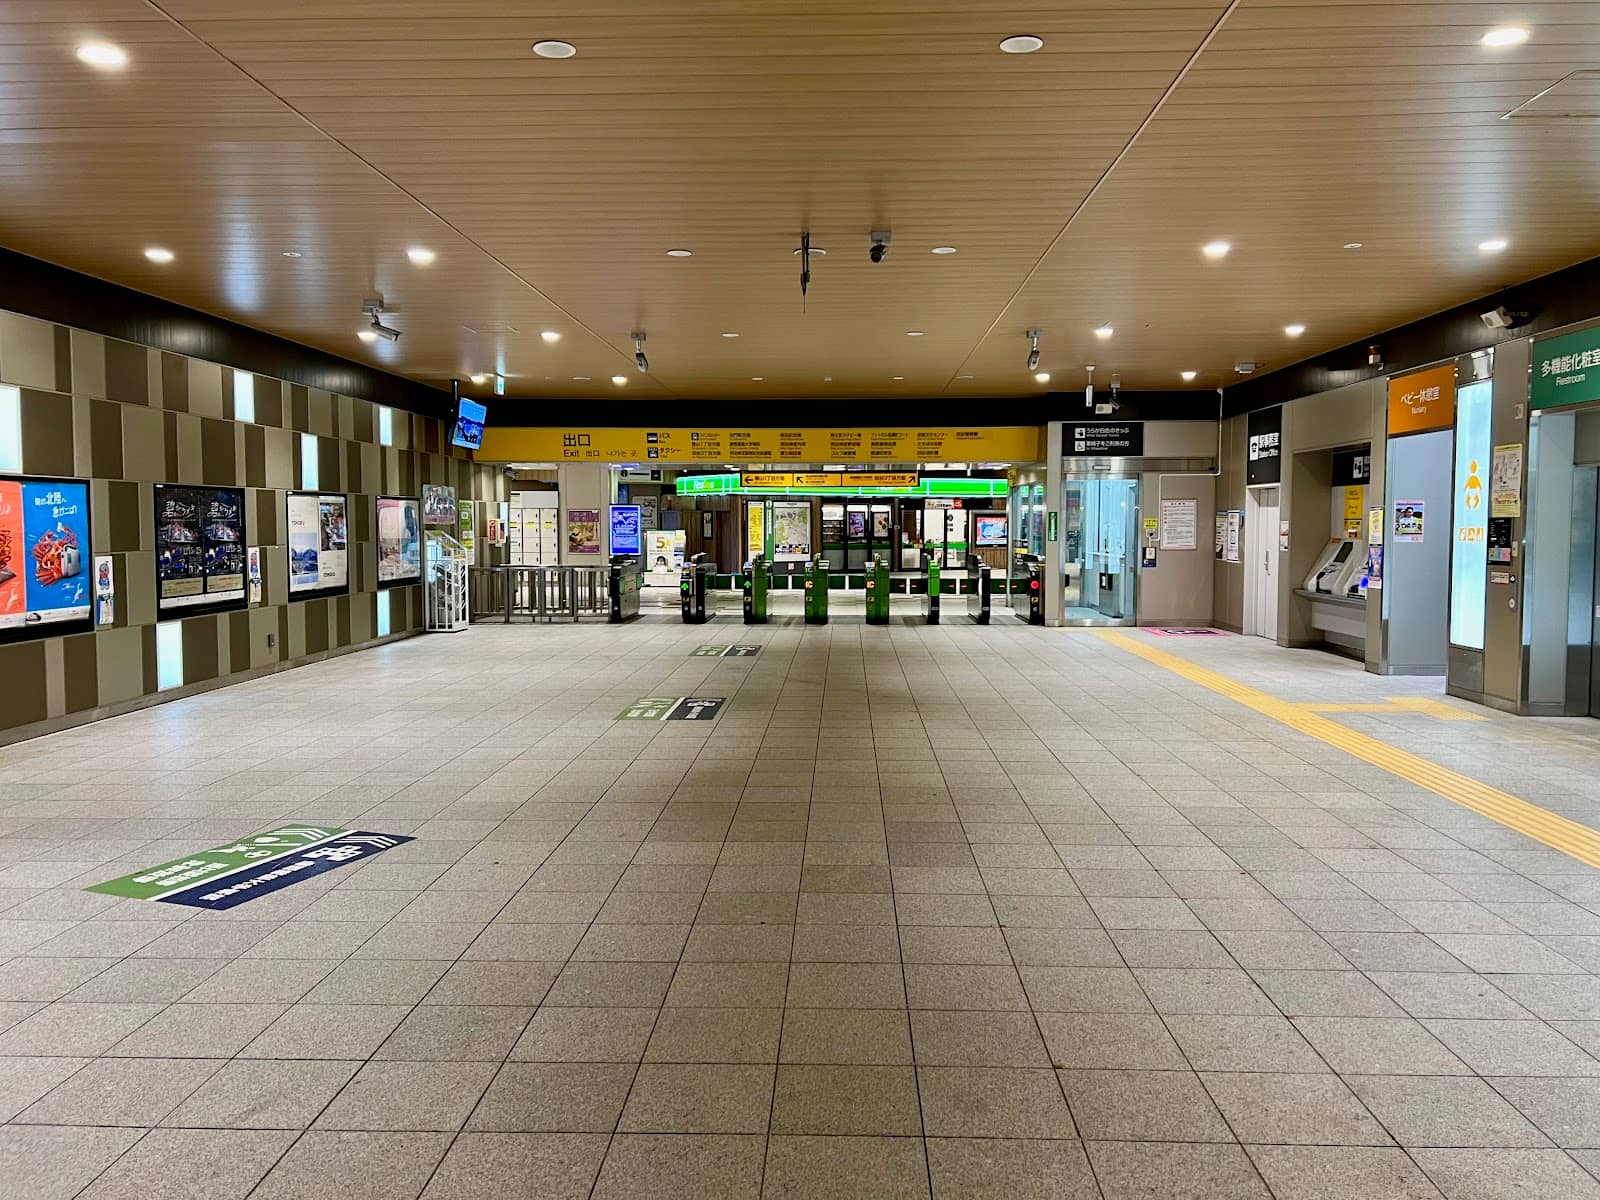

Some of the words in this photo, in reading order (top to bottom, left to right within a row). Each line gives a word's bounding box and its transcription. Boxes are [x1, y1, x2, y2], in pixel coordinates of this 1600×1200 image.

[1541, 348, 1600, 377] 多機能化粧室
[1556, 374, 1586, 386] Restroom
[563, 433, 591, 447] 出口
[659, 431, 672, 439] バス
[563, 449, 580, 458] Exit
